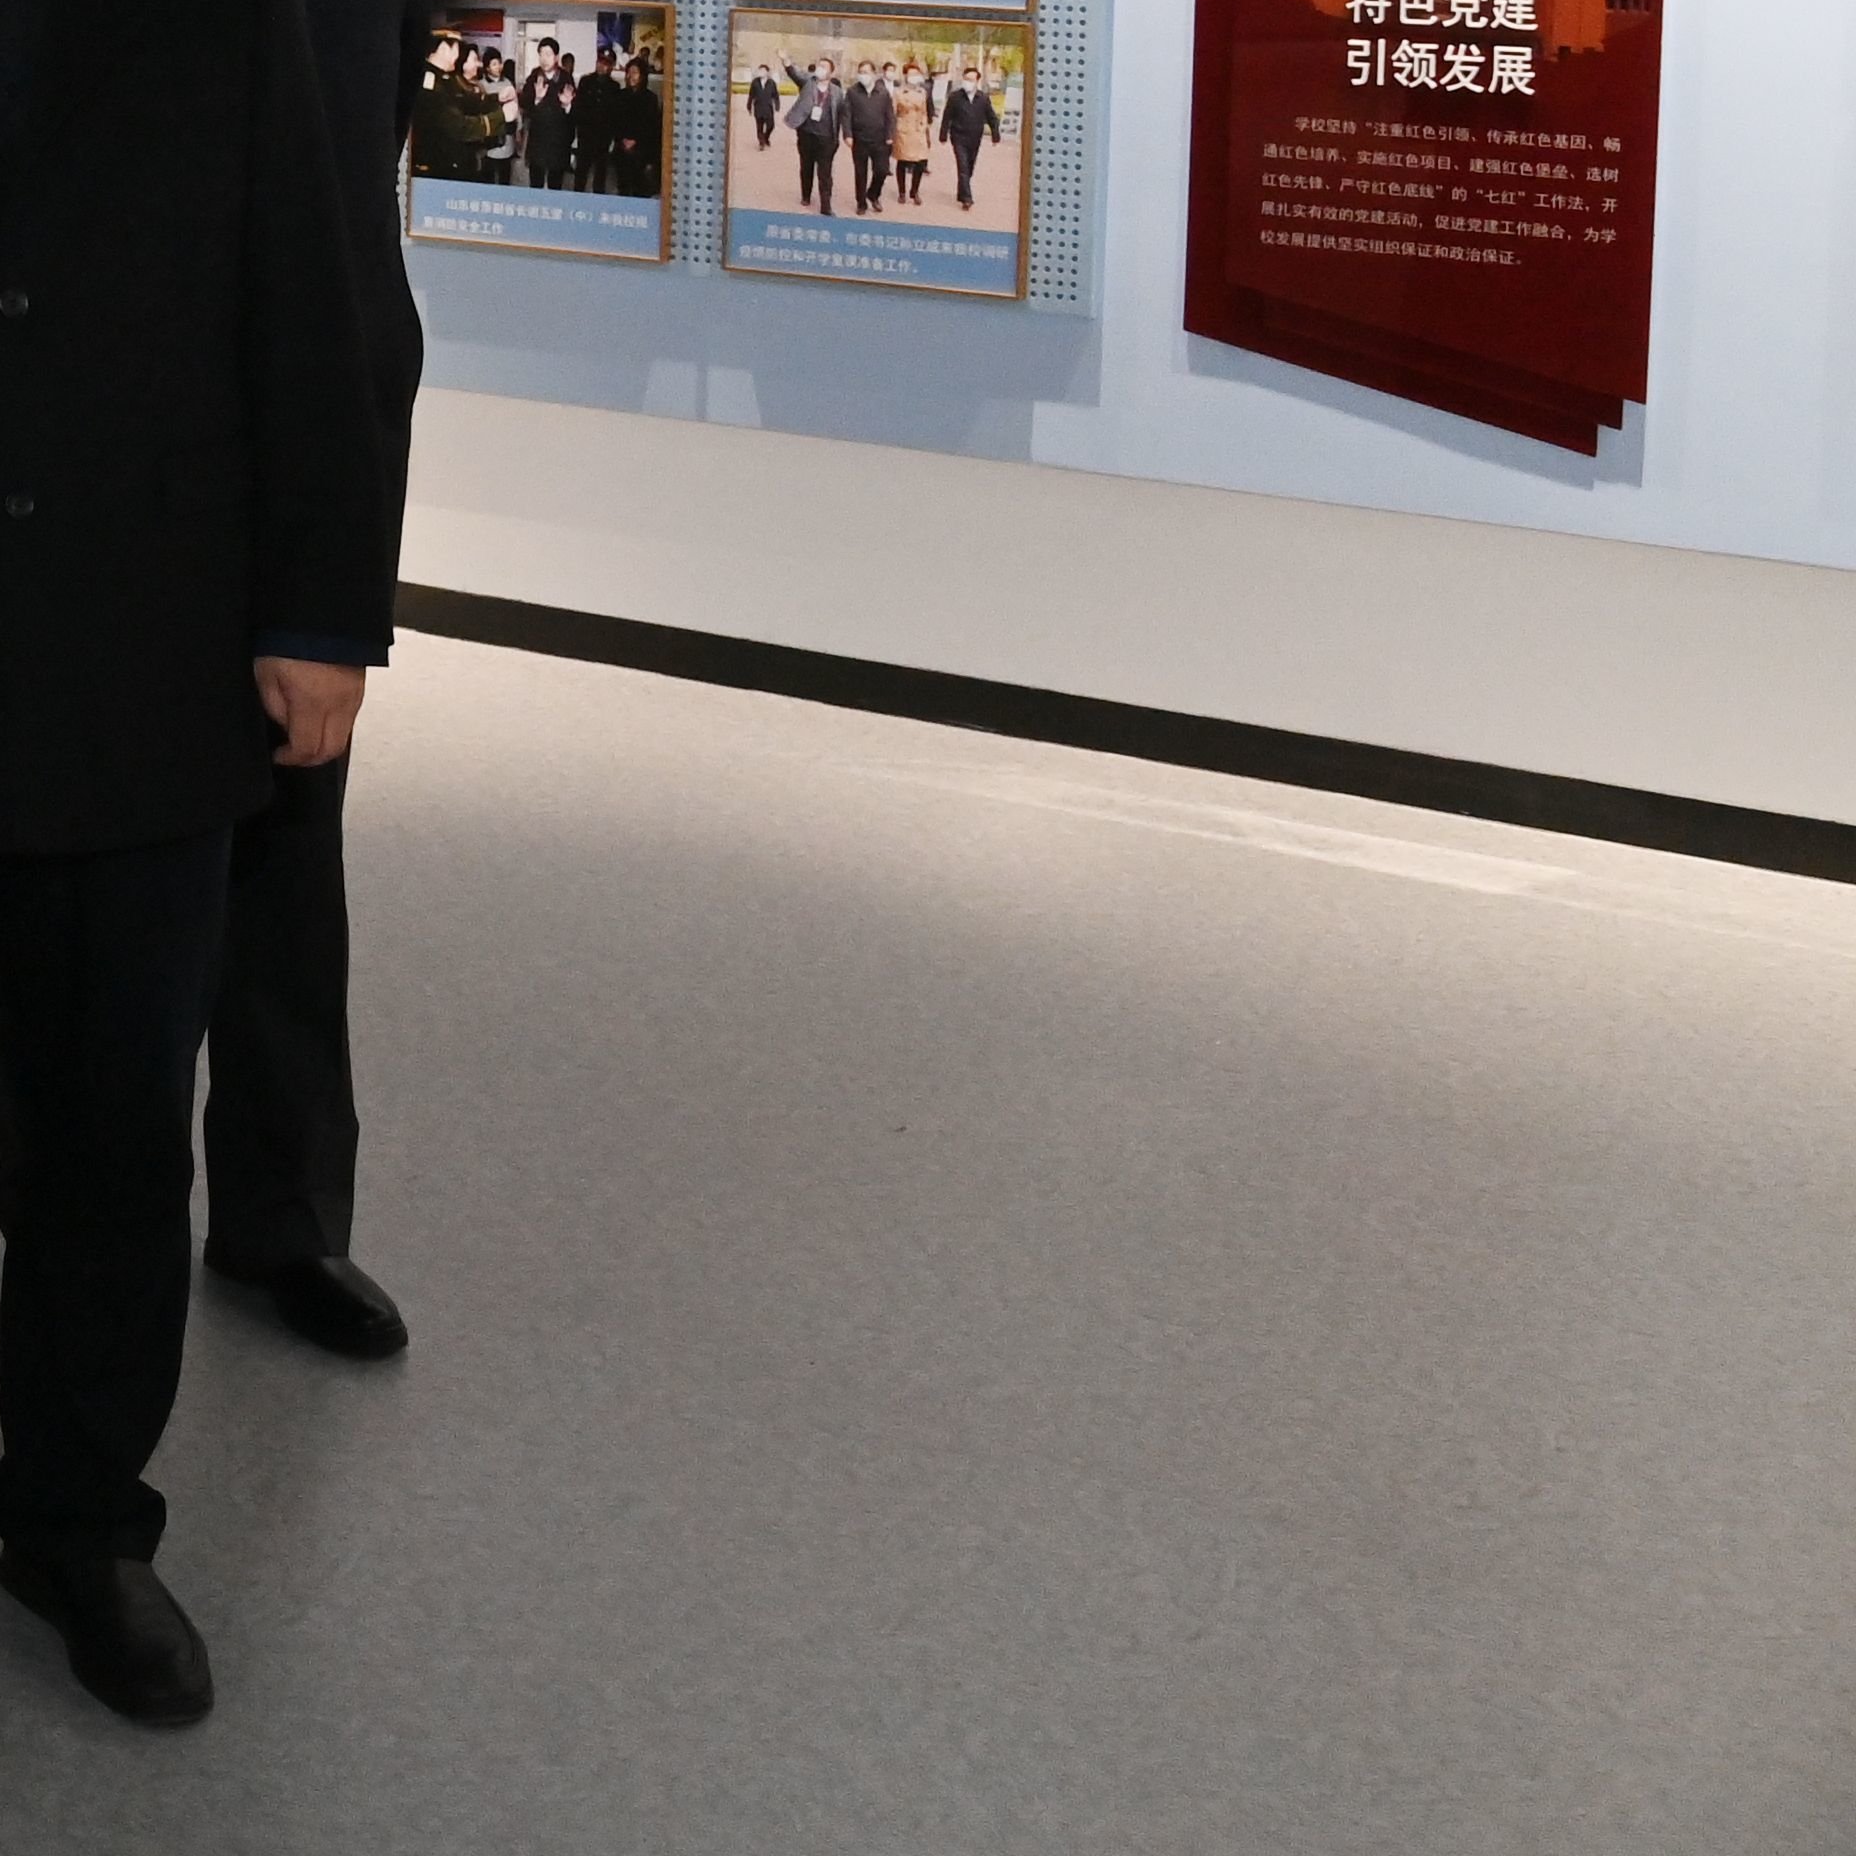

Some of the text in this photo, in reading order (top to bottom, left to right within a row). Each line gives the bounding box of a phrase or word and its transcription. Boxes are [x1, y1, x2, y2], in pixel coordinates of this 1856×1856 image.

[1345, 37, 1537, 97] 引领发展
[1295, 116, 1621, 153] 学校坚持“注重红色引领、传承红色基因、畅
[1263, 143, 1619, 183] 通红色培养、实施红色项目、建强红色堡垒、选树
[1261, 172, 1619, 213] 红色先锋、严守红色底线”的“七红”工作法，开
[1260, 200, 1617, 244] 展扎实有效的党建活动，促进党建工作融合，为学
[1260, 229, 1523, 266] 校发展提供坚实组织保证和政治保证。
